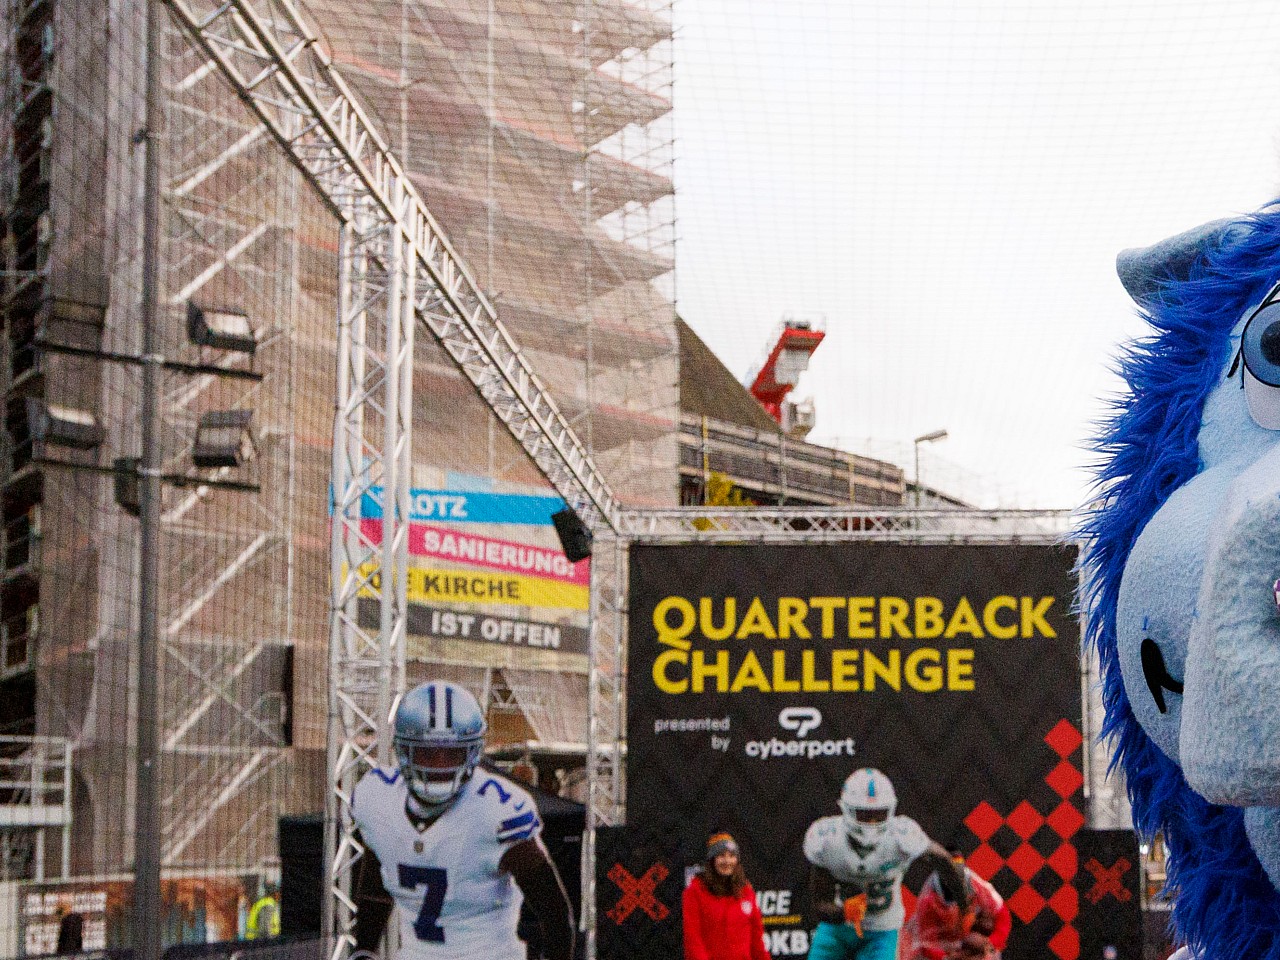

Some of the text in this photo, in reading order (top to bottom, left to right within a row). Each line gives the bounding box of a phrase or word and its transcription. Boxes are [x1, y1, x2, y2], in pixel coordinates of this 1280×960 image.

[423, 530, 575, 577] SANIERUNG!
[424, 574, 519, 599] KIRCHE
[431, 610, 561, 648] IST OFFEN
[652, 596, 1058, 650] QUARTERBACK
[652, 648, 976, 694] CHALLENGE
[654, 716, 731, 732] presented
[711, 735, 731, 752] by
[745, 736, 855, 759] cyberport
[398, 864, 447, 943] 7
